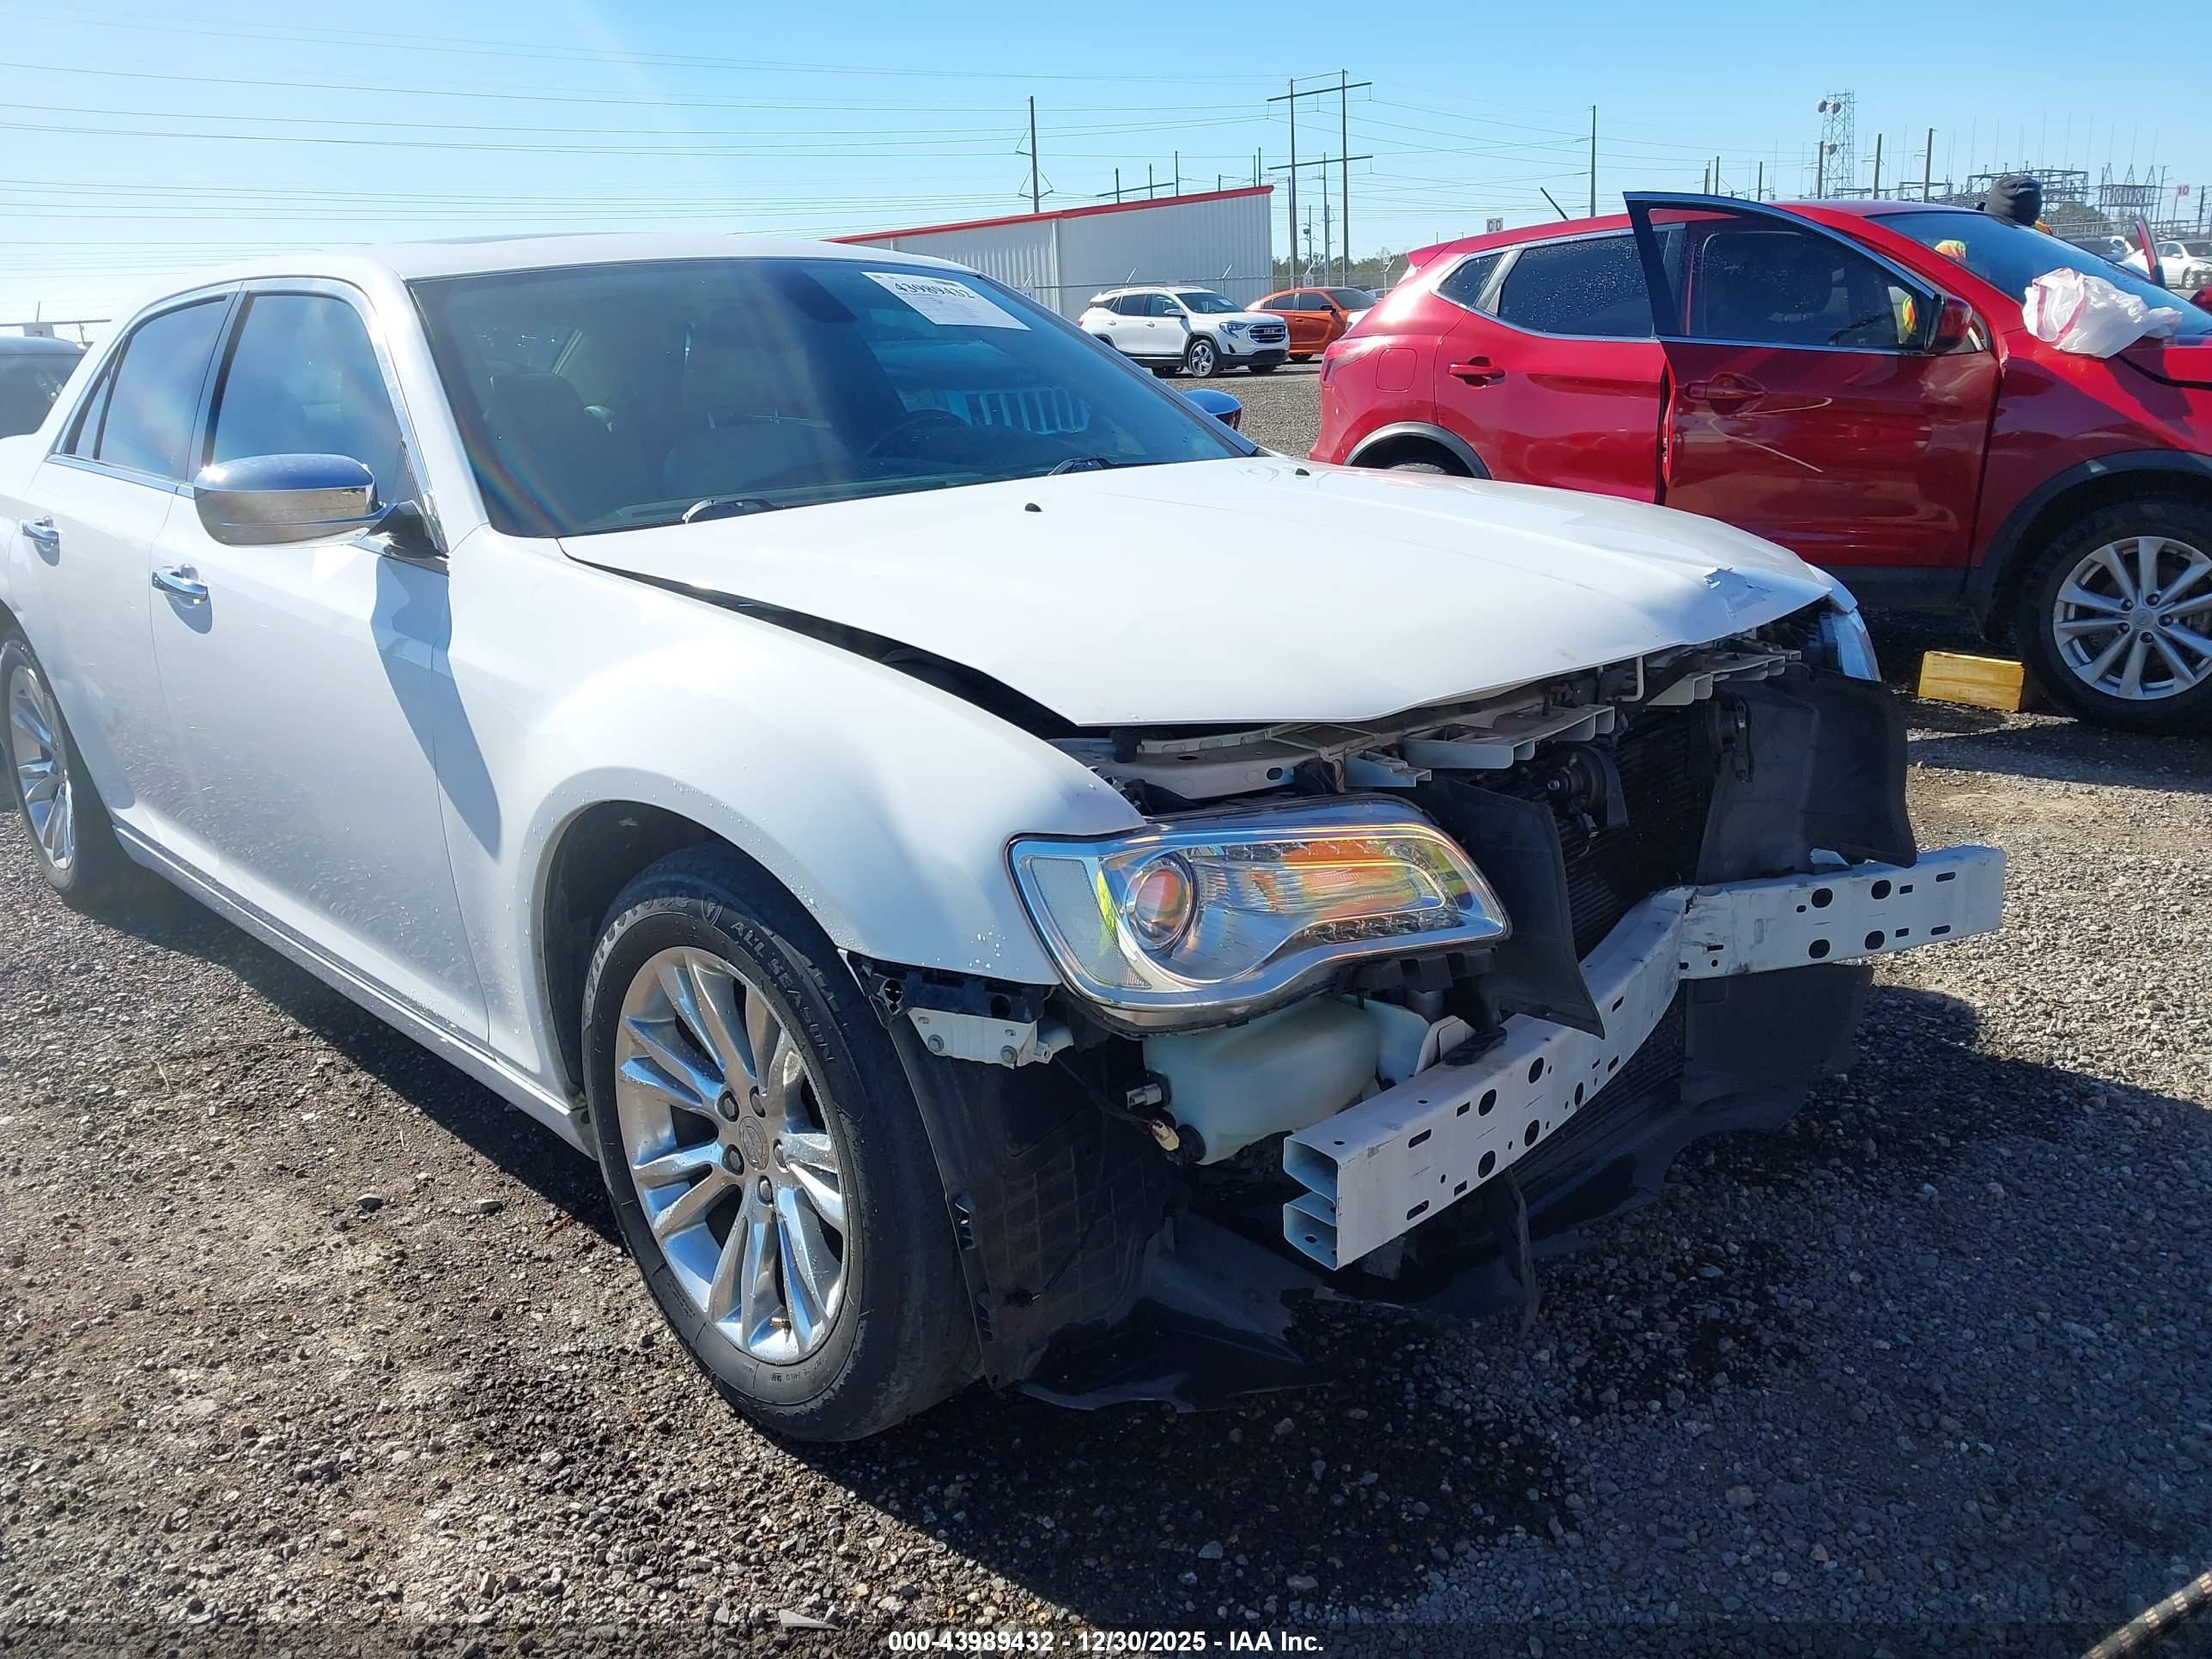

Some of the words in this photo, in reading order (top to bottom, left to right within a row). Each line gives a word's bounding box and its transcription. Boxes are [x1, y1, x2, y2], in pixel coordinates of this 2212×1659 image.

[2179, 185, 2189, 195] 10
[895, 283, 975, 299] 43989432
[731, 921, 765, 958] ALL
